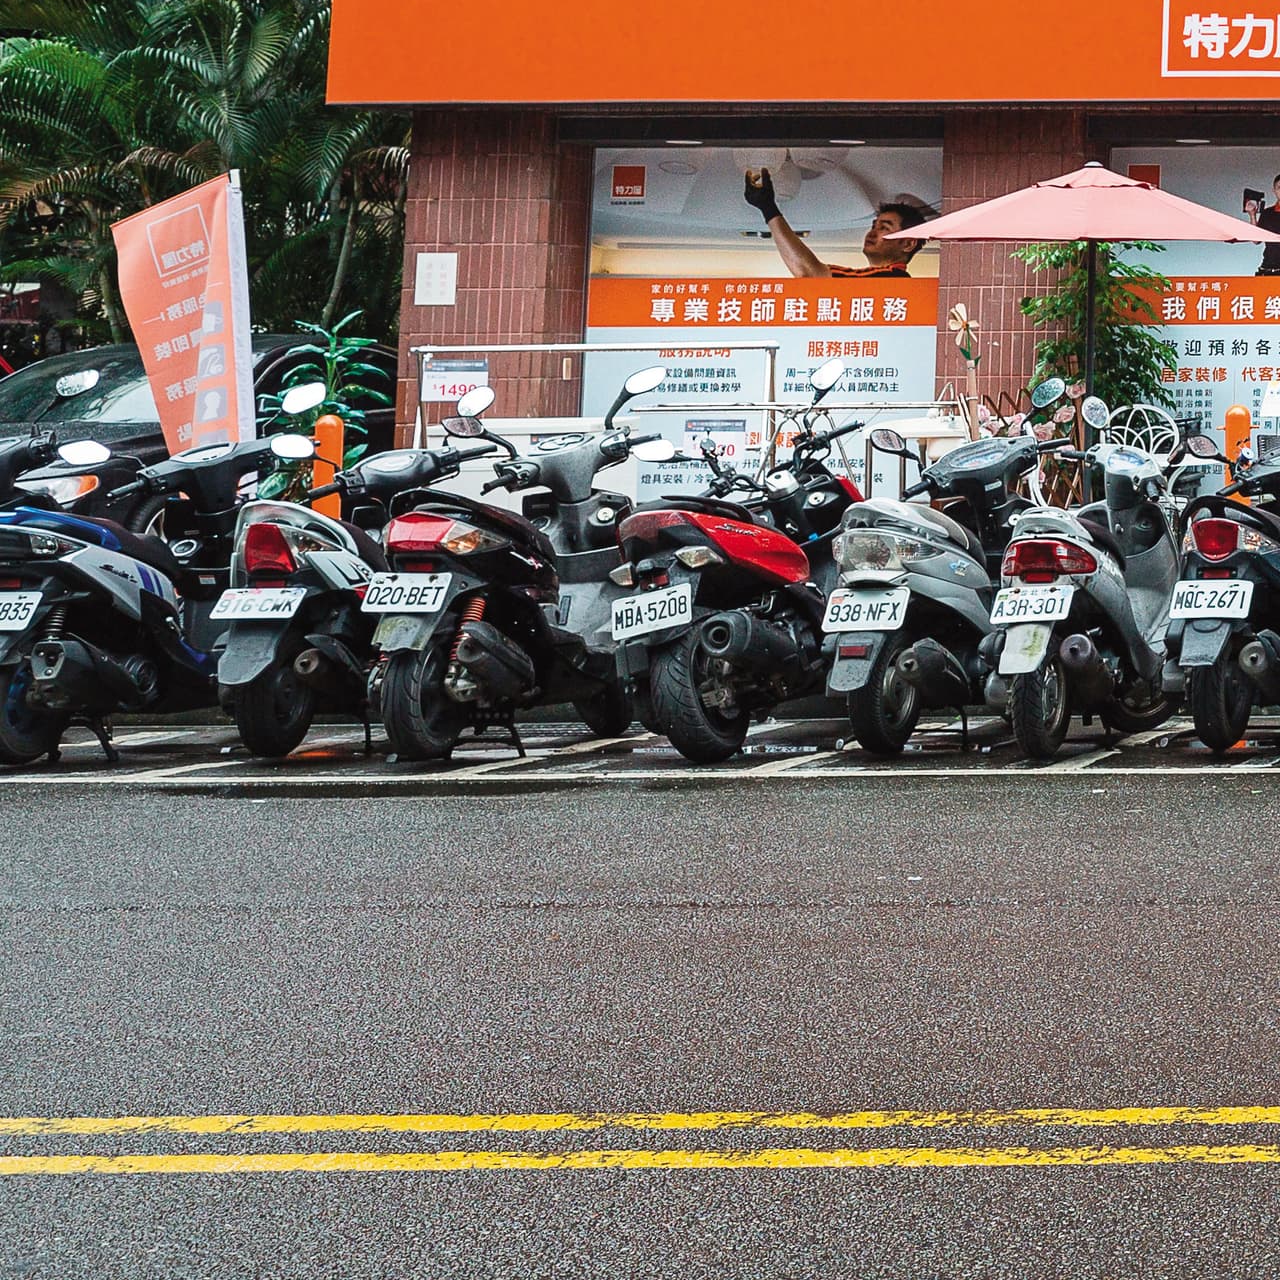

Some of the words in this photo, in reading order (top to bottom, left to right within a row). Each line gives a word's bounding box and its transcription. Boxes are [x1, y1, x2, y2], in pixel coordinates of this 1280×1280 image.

[651, 283, 710, 294] 家的好幫手
[650, 296, 908, 323] 專業技師駐點服務
[807, 340, 879, 358] 服務時間
[1160, 366, 1227, 383] 居家裝修
